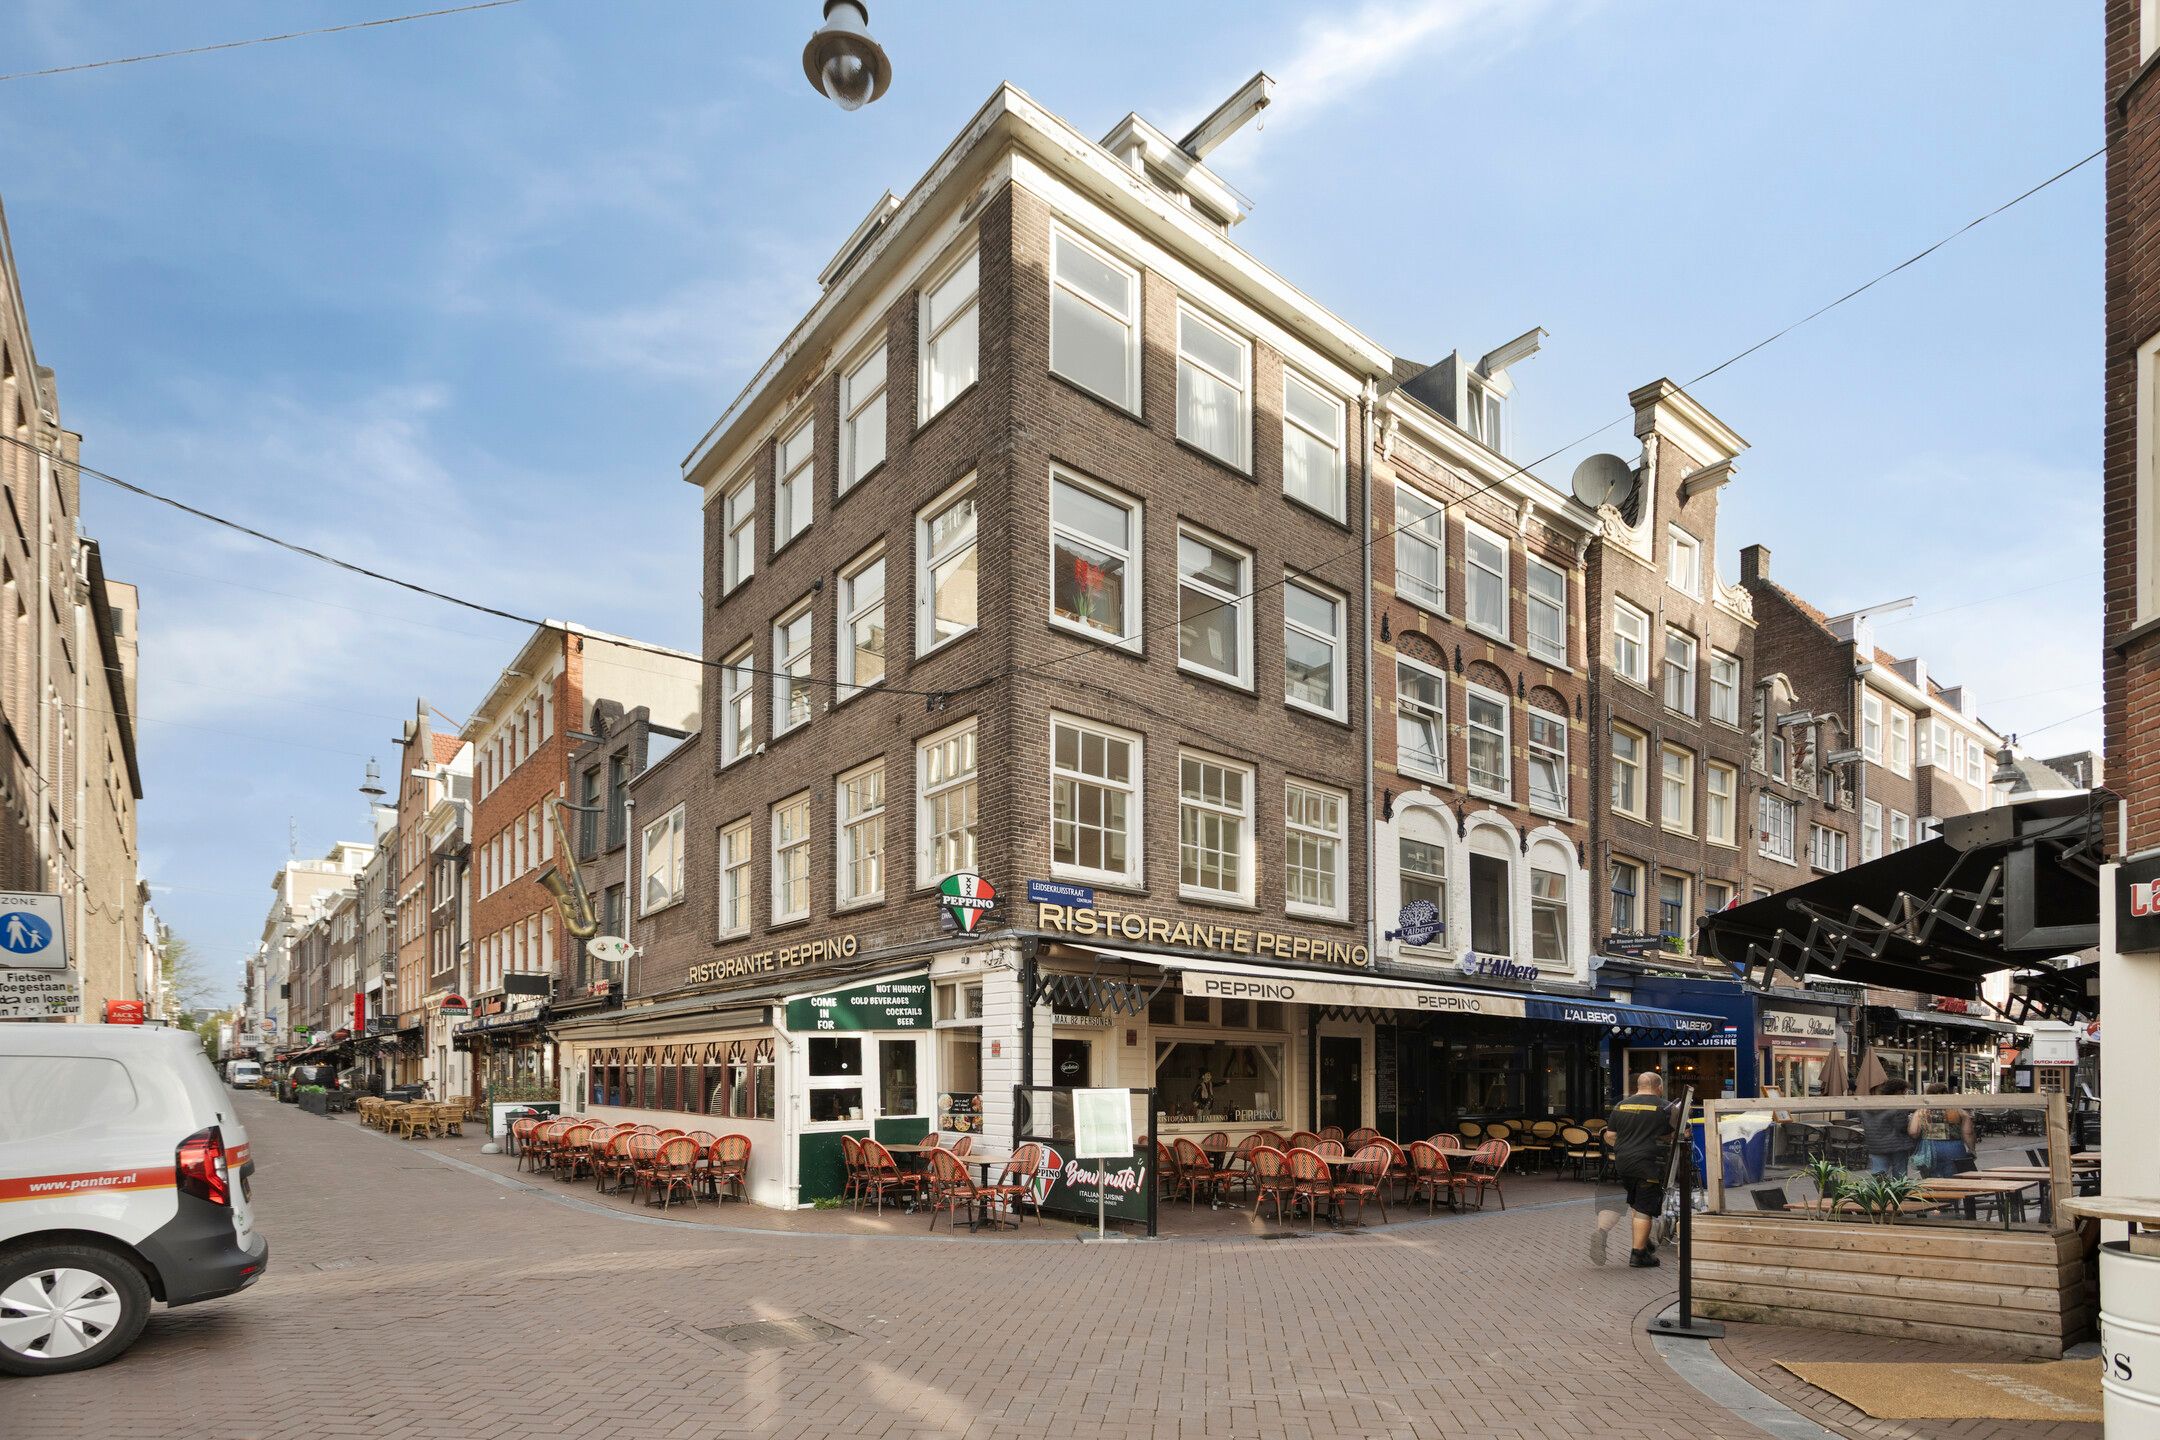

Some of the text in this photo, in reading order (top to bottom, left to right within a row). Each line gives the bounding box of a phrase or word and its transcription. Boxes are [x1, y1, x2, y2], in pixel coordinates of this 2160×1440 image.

[1, 897, 38, 906] ZONE
[942, 895, 995, 909] PEPPINO
[1038, 903, 1369, 967] RISTORANTE PEPPINO
[1401, 926, 1434, 937] L'Albero
[688, 934, 857, 984] RISTORANTE PEPPINO
[1478, 957, 1539, 981] L'Albero
[7, 973, 52, 982] Fietsen
[0, 983, 66, 994] Toegestaan
[876, 985, 926, 994] NOT HUNGRY?
[1205, 980, 1295, 1000] PEPPINO
[43, 994, 80, 1003] lossen
[811, 998, 838, 1007] COME
[850, 997, 909, 1005] COLD BEVERAGES
[1417, 995, 1480, 1011] PEPPINO
[12, 1006, 19, 1015] 7
[45, 1005, 58, 1014] 12
[820, 1009, 829, 1018] IN
[886, 1008, 922, 1016] COCKTAILS
[897, 1018, 914, 1026] BEER
[1071, 1015, 1078, 1024] 82
[1080, 1016, 1113, 1026] PERSONEN
[1564, 1009, 1617, 1024] L'ALBERO
[817, 1020, 835, 1029] FOR
[1675, 1019, 1712, 1031] L'ALBERO
[1157, 1115, 1195, 1123] RISTORANTE
[1235, 1109, 1279, 1121] PEPPINO
[29, 1172, 137, 1191] www.pantar.nl
[1065, 1159, 1146, 1194] Benvnuto!
[1079, 1190, 1100, 1198] ITALIAN
